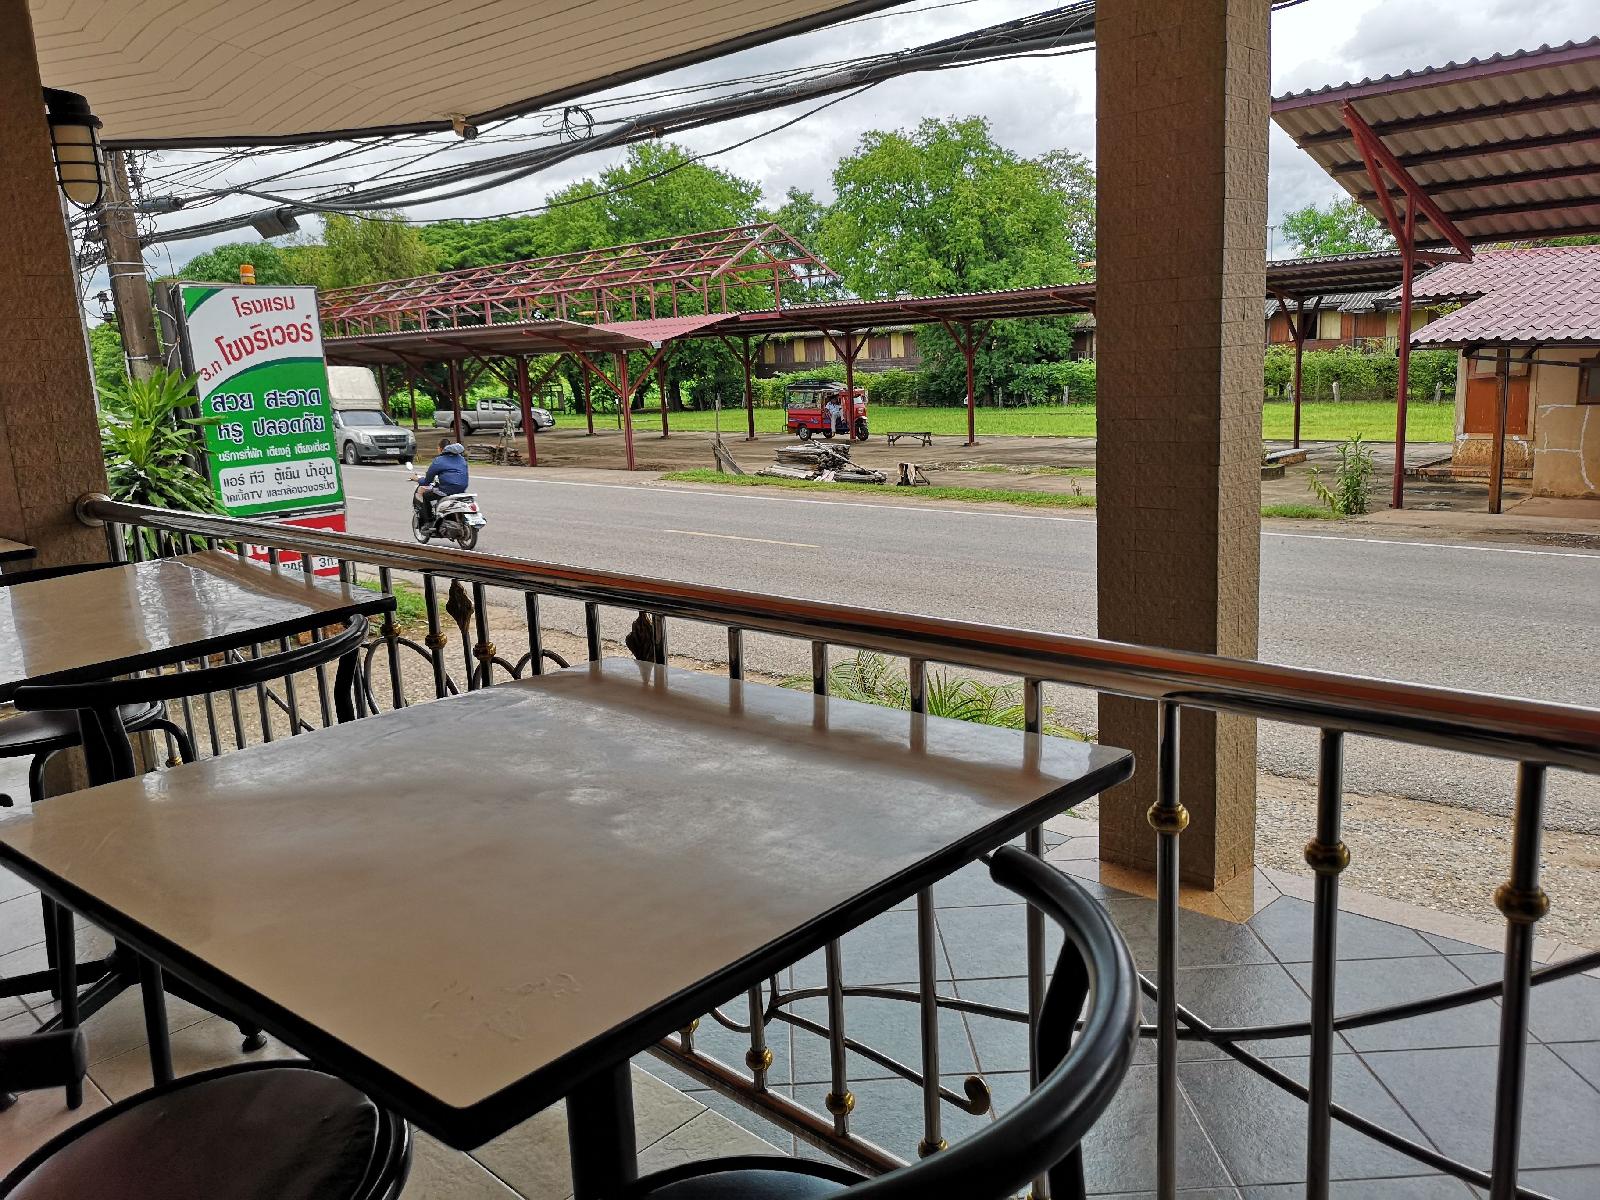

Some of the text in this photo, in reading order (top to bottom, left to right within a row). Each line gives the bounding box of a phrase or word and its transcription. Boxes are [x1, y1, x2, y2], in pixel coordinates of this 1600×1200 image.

[231, 295, 296, 318] โรงแรม
[211, 388, 322, 413] สวย สะอาด
[217, 412, 325, 444] หรู ปลอดภัย
[223, 473, 246, 487] แอร์
[249, 470, 265, 484] ทีวี
[305, 461, 333, 479] น้ำอุ่น
